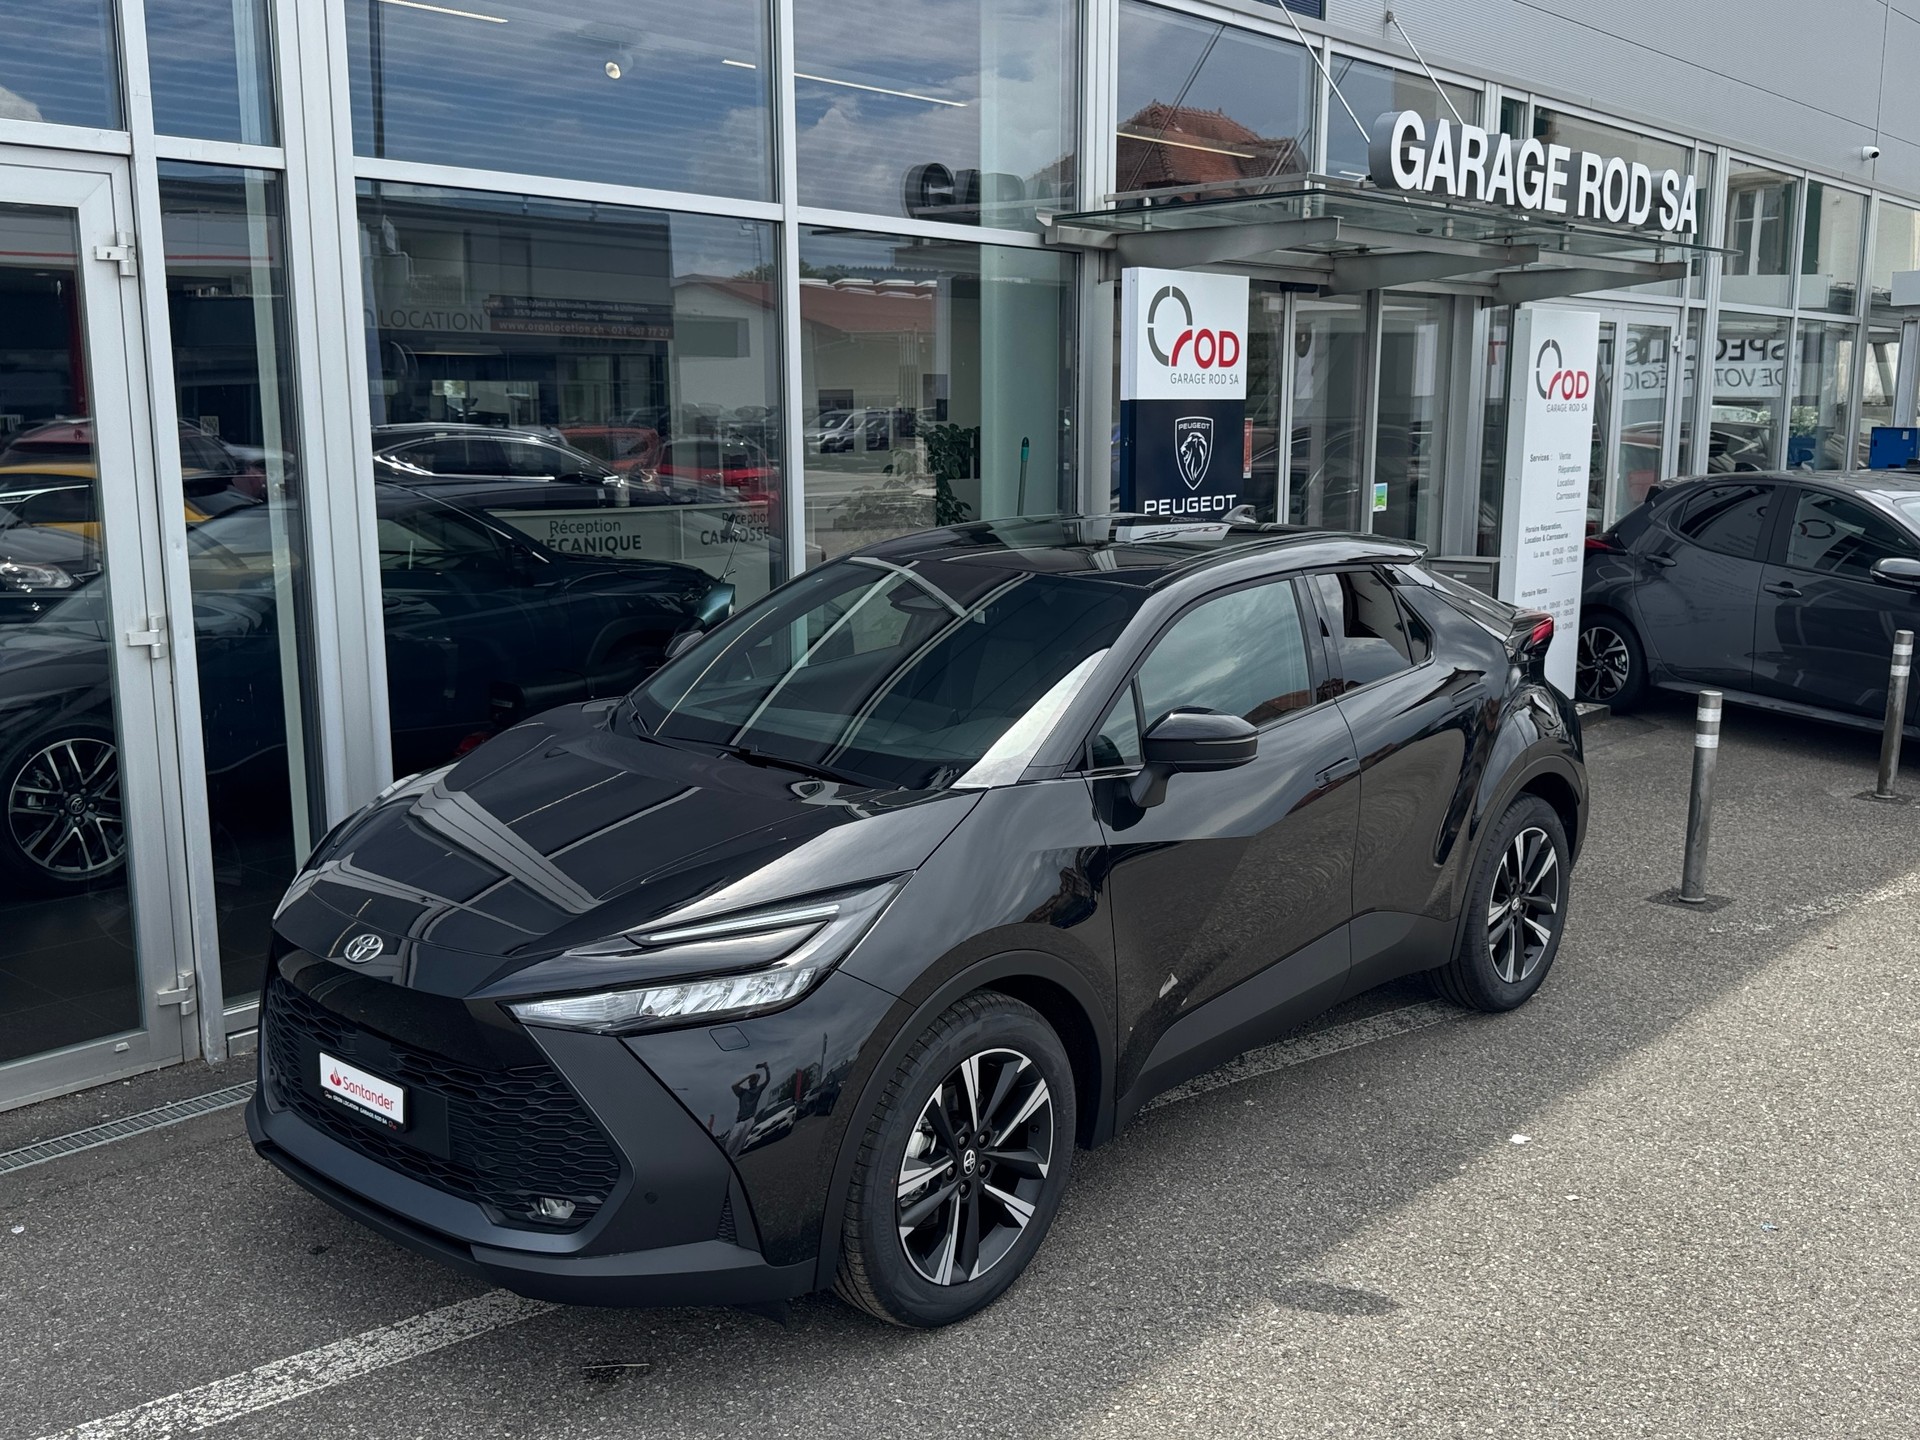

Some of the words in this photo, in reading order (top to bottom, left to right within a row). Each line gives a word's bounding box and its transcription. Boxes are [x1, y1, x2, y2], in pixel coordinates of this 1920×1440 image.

[1390, 110, 1571, 214] GARAGE
[1578, 151, 1652, 226] ROD
[1659, 169, 1698, 235] SA
[380, 309, 483, 331] LOCATION
[611, 326, 628, 335] 021
[1170, 372, 1206, 385] GARAGE
[1208, 373, 1227, 385] ROD
[1229, 373, 1240, 385] SA
[1546, 403, 1567, 413] GARAGE
[1568, 403, 1580, 412] ROD
[1581, 402, 1588, 412] SA
[1178, 422, 1210, 431] PEUGEOT
[1529, 453, 1550, 463] Services
[1556, 479, 1575, 488] Location
[1556, 492, 1580, 501] Carrosserie
[1144, 494, 1237, 516] PEUGEOT
[549, 520, 621, 536] Réception
[540, 535, 642, 554] ÉCANIQUE
[343, 1076, 394, 1111] Santander
